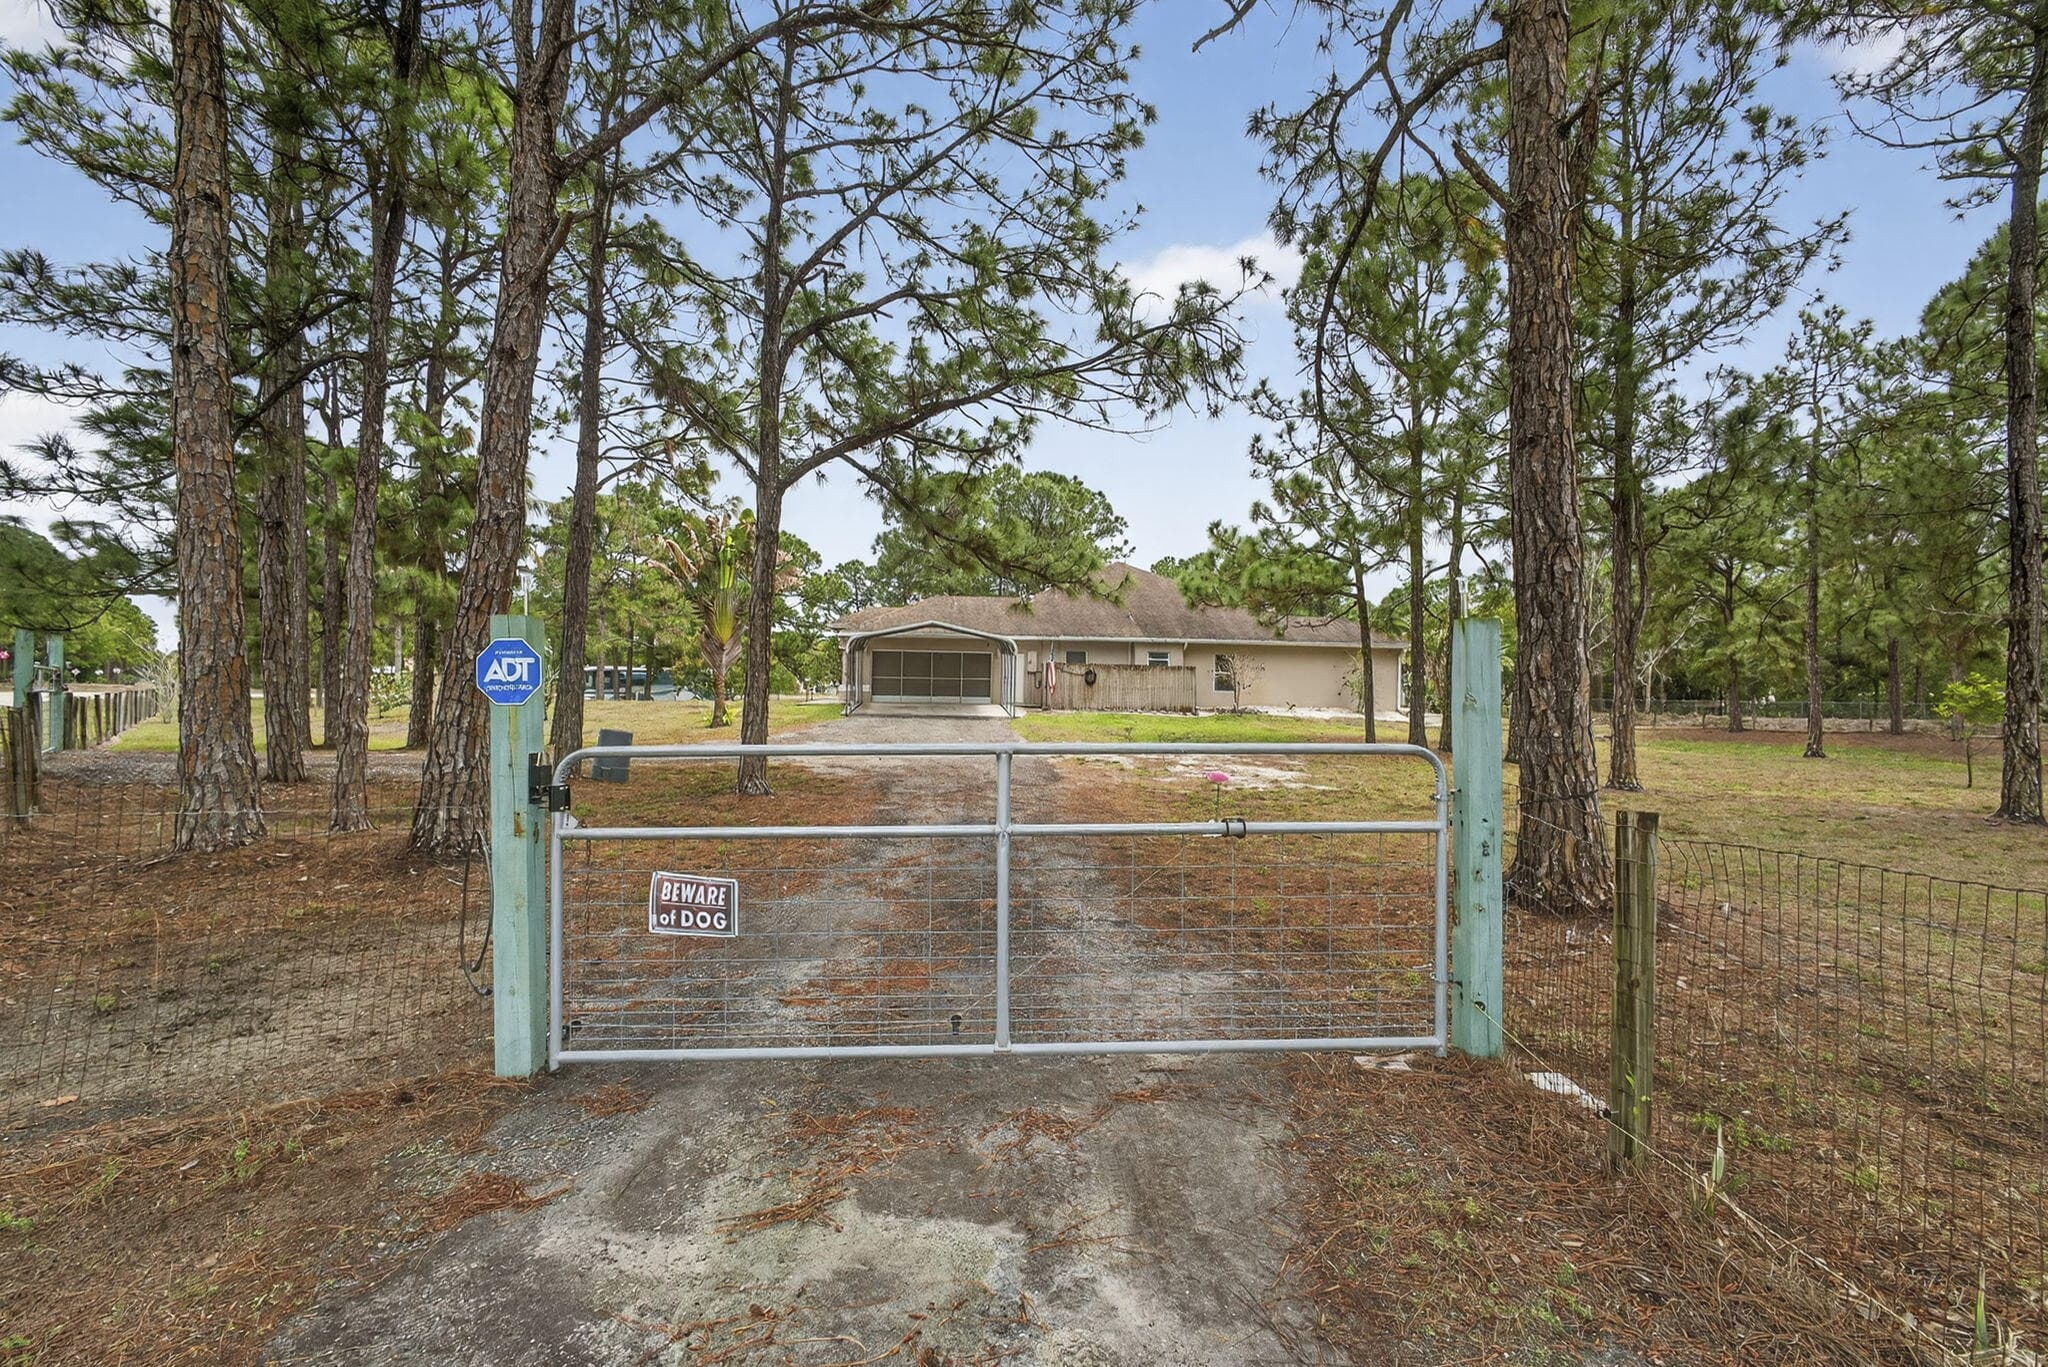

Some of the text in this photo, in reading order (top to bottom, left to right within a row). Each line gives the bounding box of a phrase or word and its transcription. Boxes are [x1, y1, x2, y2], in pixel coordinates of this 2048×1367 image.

[483, 657, 536, 683] ADT
[661, 881, 727, 906] BEWARE
[660, 909, 728, 930] of DOG
